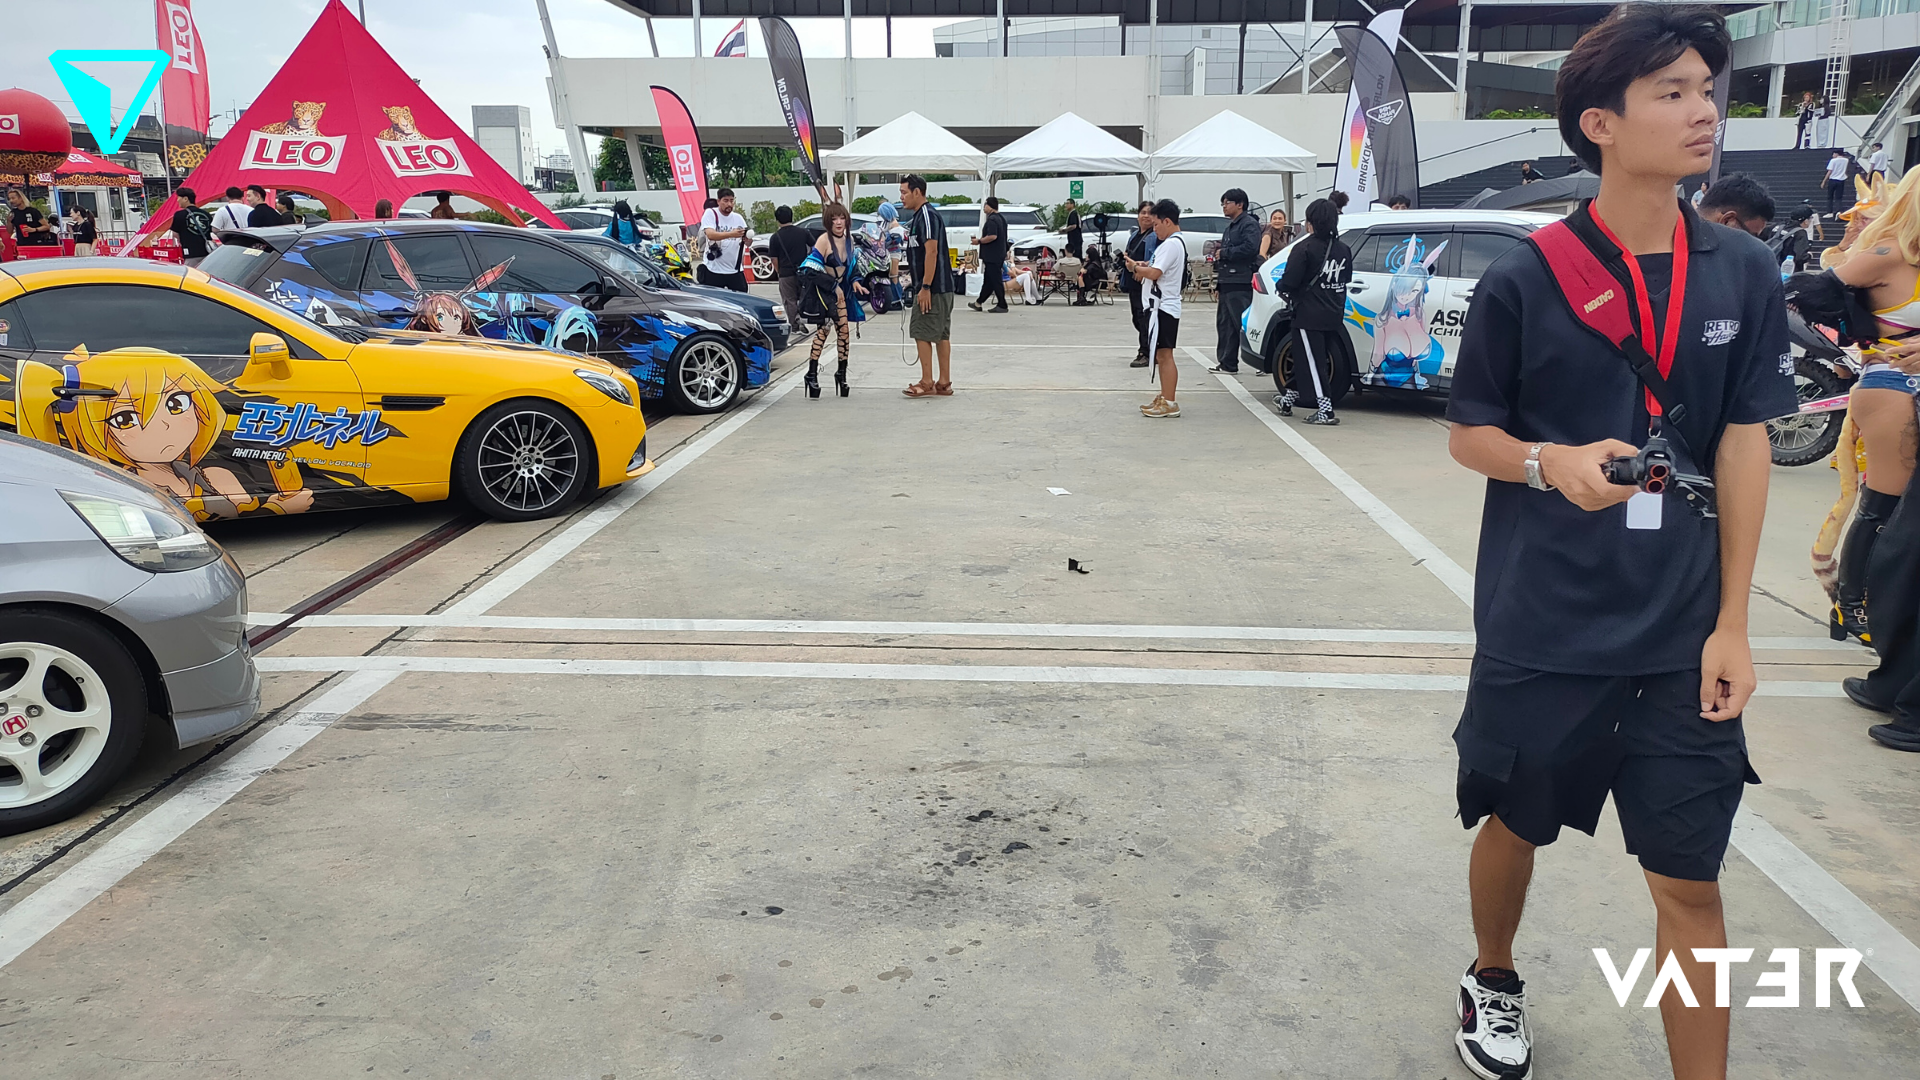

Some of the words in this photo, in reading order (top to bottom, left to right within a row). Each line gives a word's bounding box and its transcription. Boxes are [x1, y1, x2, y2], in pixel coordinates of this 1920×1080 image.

[172, 10, 192, 66] LEO
[252, 137, 335, 168] LEO
[386, 143, 458, 172] LEO
[1357, 141, 1374, 193] BANGKOK
[1704, 321, 1739, 334] RETRO
[232, 447, 260, 459] AKITA
[260, 450, 286, 461] NERU
